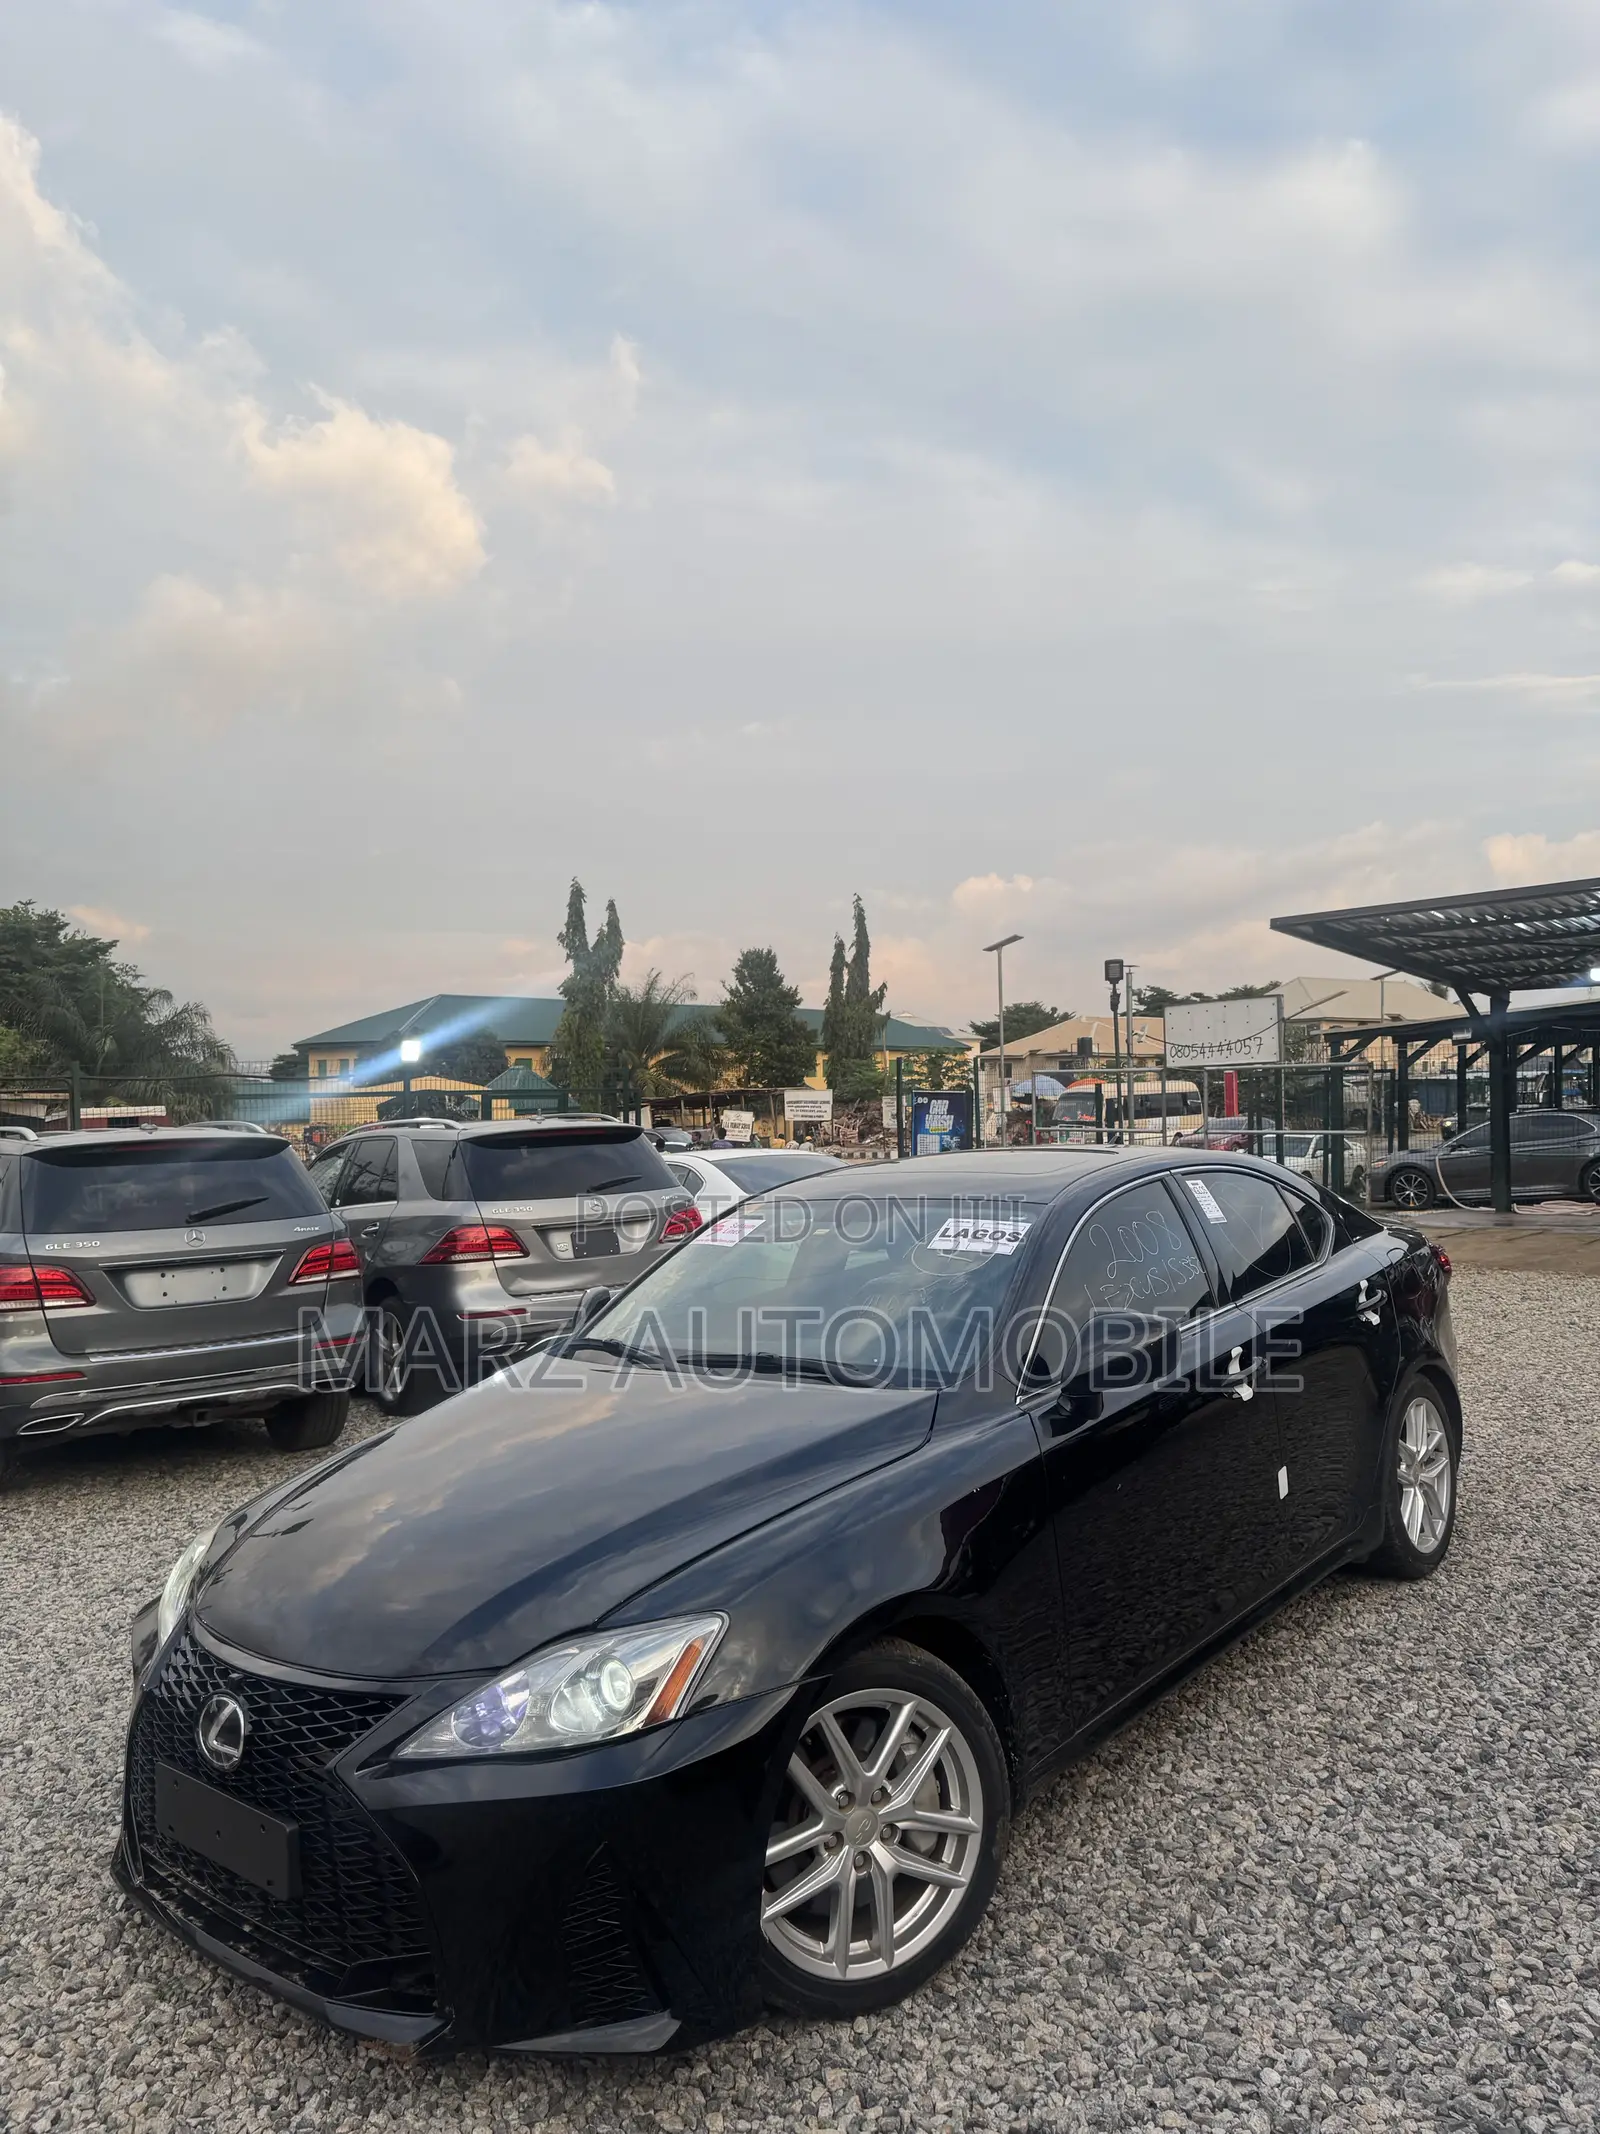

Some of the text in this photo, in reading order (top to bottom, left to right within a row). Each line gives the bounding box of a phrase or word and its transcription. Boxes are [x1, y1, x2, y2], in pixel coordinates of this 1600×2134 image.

[1169, 1036, 1263, 1059] 08054444057
[939, 1227, 1023, 1243] LAGOS
[1089, 1210, 1182, 1279] 2008
[45, 1240, 100, 1251] GLE 350
